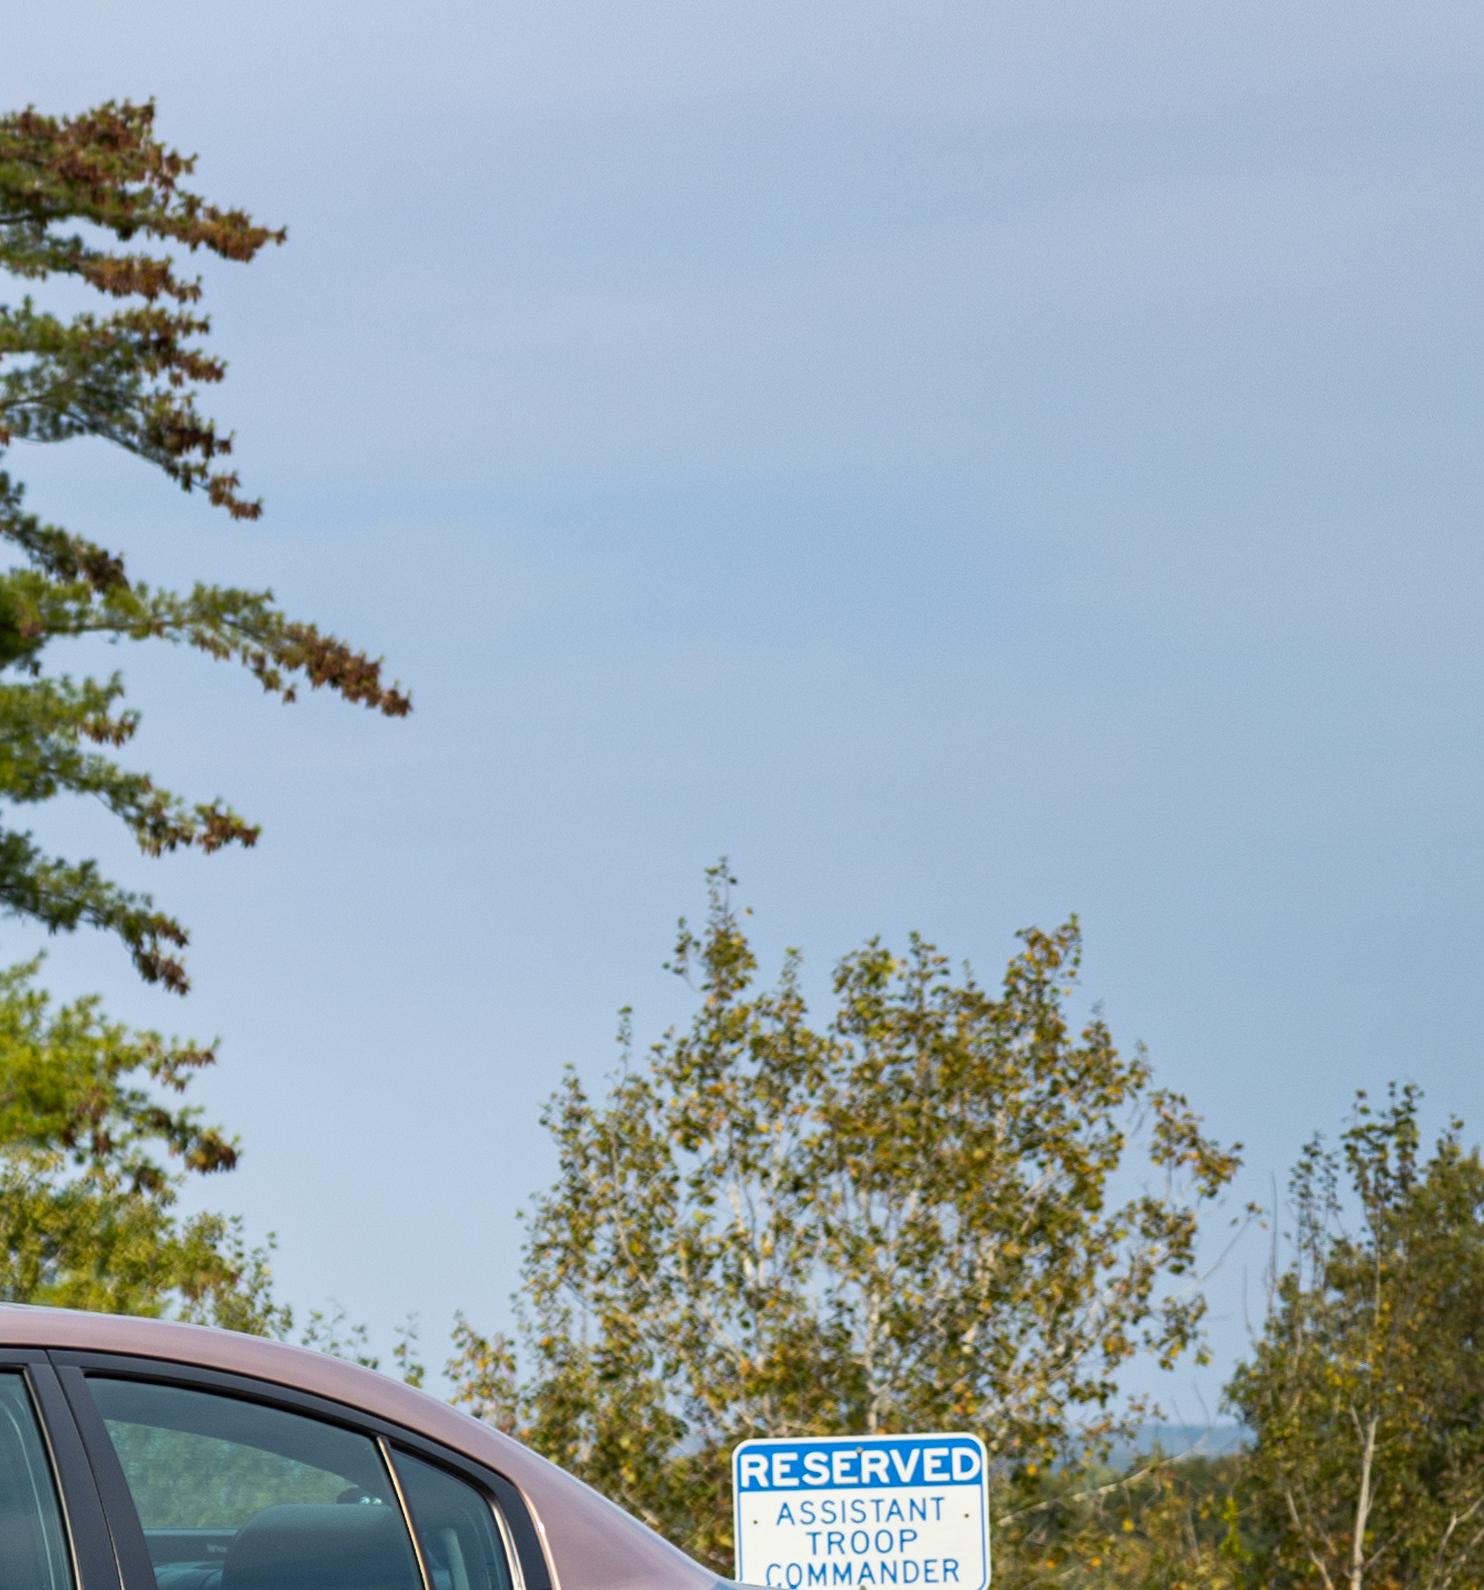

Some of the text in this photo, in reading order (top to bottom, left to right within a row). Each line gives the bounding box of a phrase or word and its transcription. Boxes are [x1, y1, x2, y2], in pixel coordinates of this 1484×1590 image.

[740, 1446, 981, 1488] RESERVED
[776, 1496, 946, 1526] ASSISTANT
[805, 1528, 918, 1556] TROOP
[766, 1558, 960, 1590] COMMANDER
